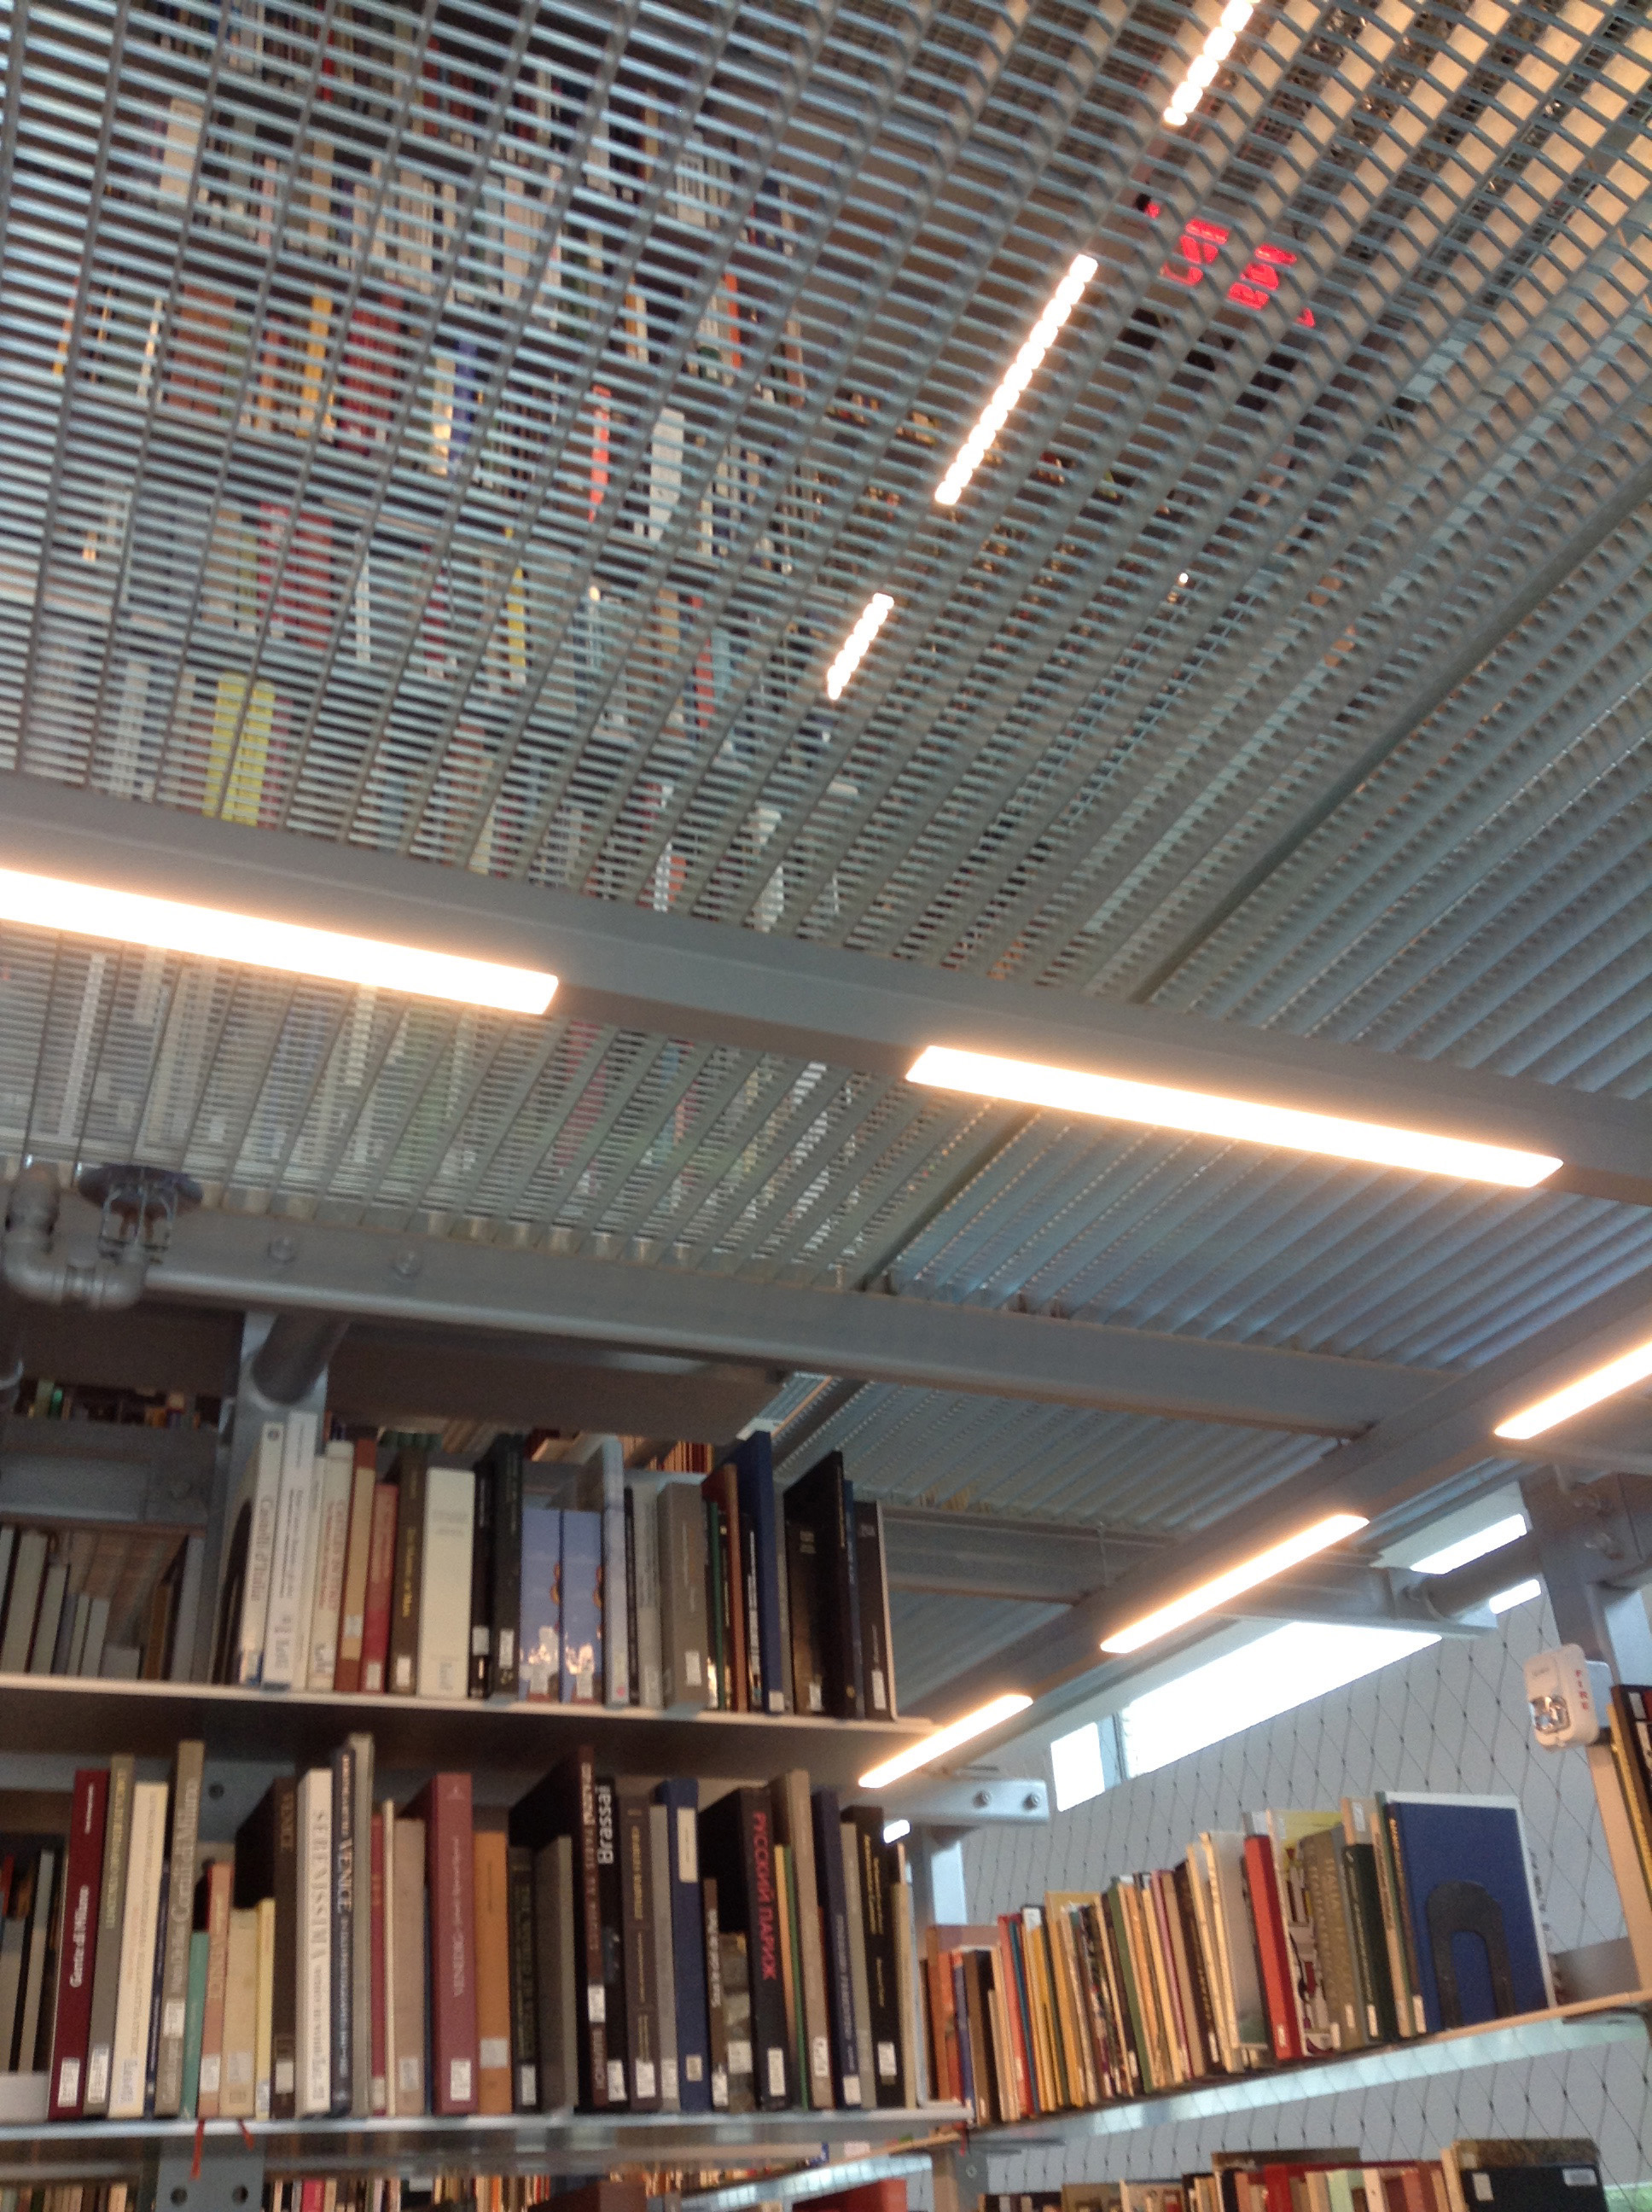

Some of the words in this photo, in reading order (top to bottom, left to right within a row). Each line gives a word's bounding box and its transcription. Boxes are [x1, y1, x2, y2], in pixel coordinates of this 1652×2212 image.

[1575, 1669, 1589, 1710] FIRE
[337, 1837, 353, 1914] VENICE
[753, 1811, 776, 1904] РУССКИЙ
[73, 1884, 89, 1931] Milano
[69, 1945, 84, 1988] Gente
[759, 1907, 777, 1981] ПАРИЖ
